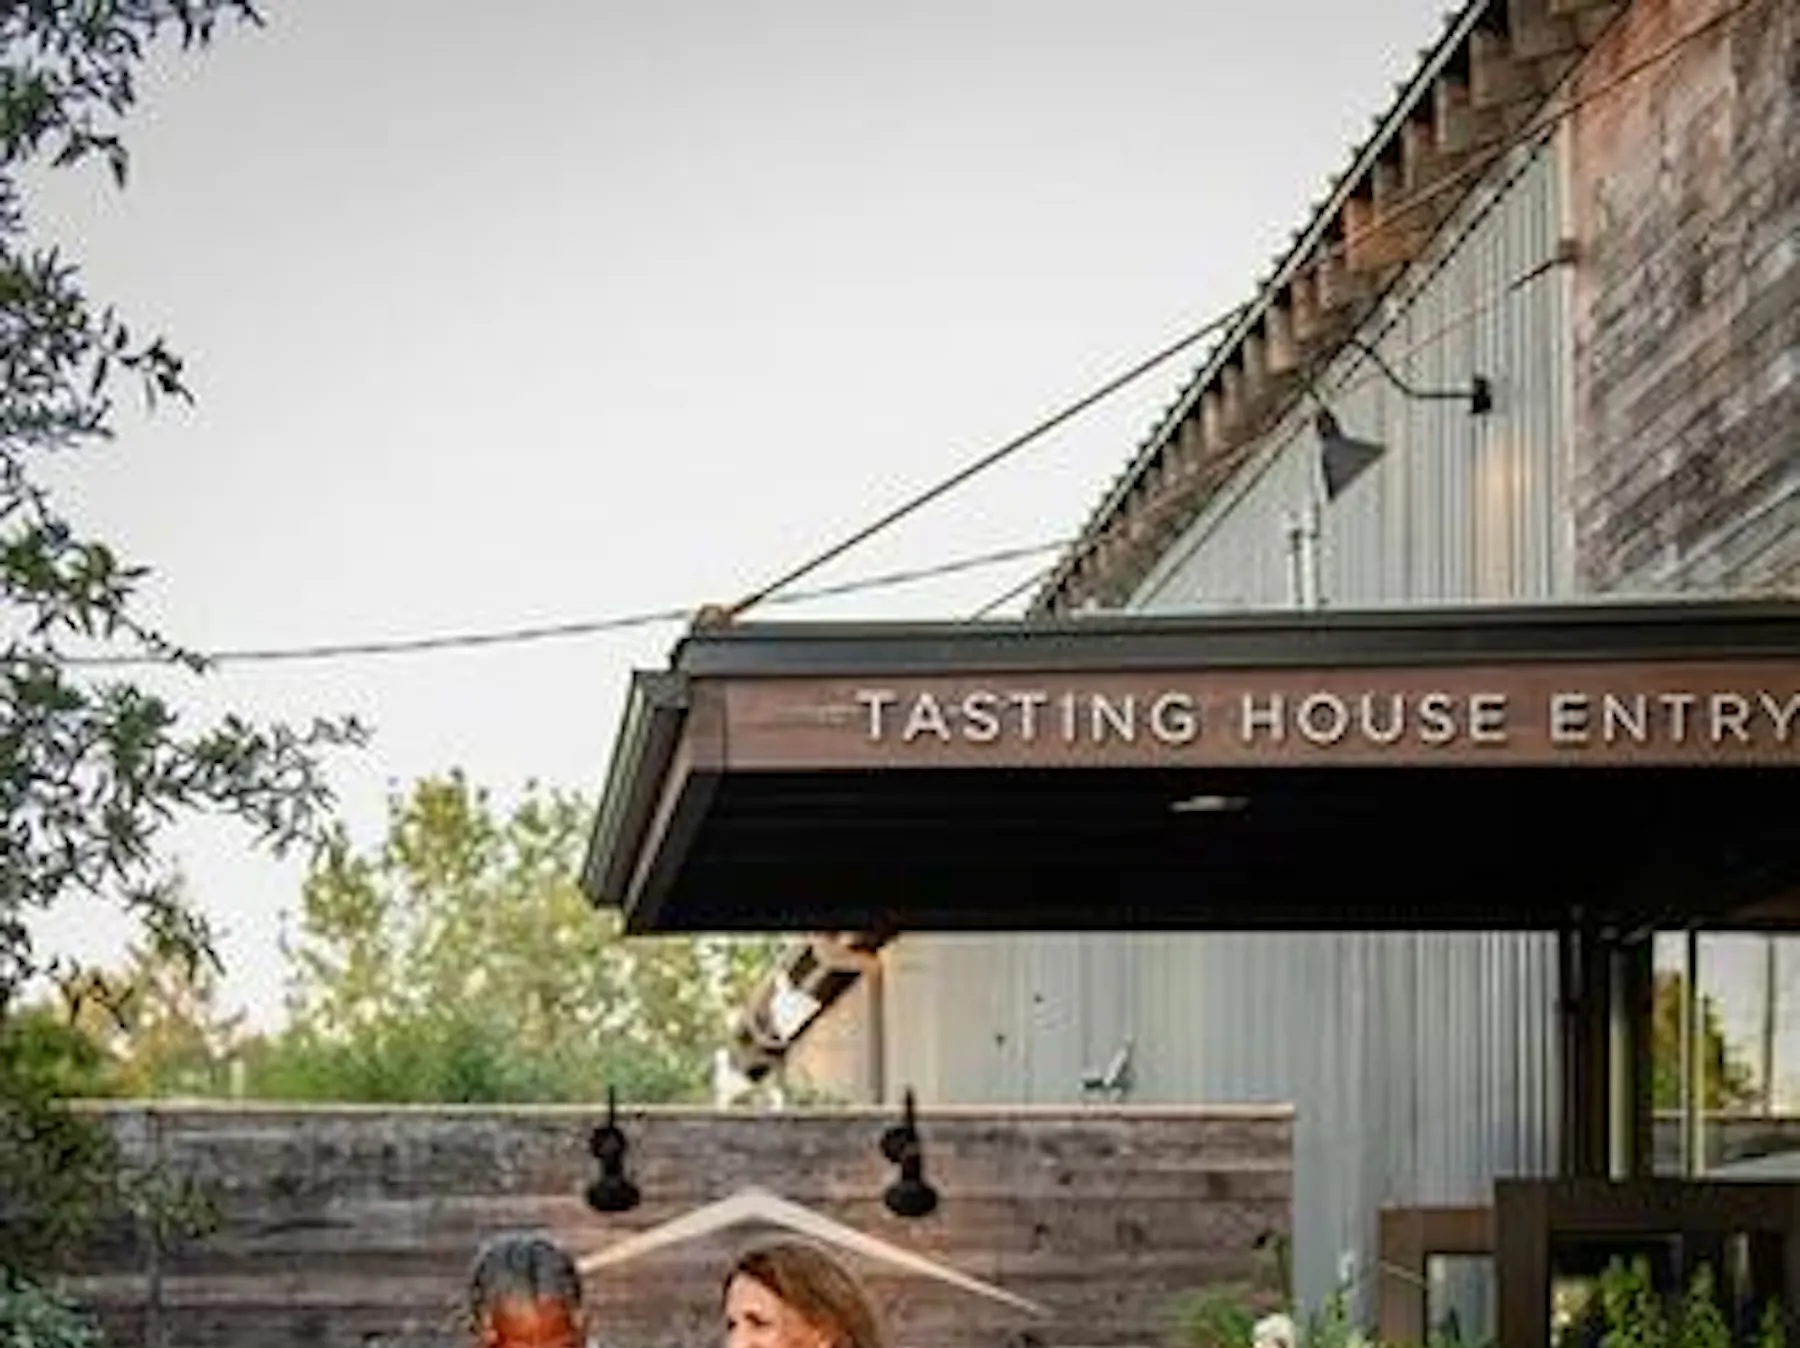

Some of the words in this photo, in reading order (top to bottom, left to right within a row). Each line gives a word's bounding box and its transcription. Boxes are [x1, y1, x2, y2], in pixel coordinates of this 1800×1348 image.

[856, 689, 1198, 744] TASTING
[1241, 692, 1508, 743] HOUSE
[1551, 690, 1800, 742] ENTRY
